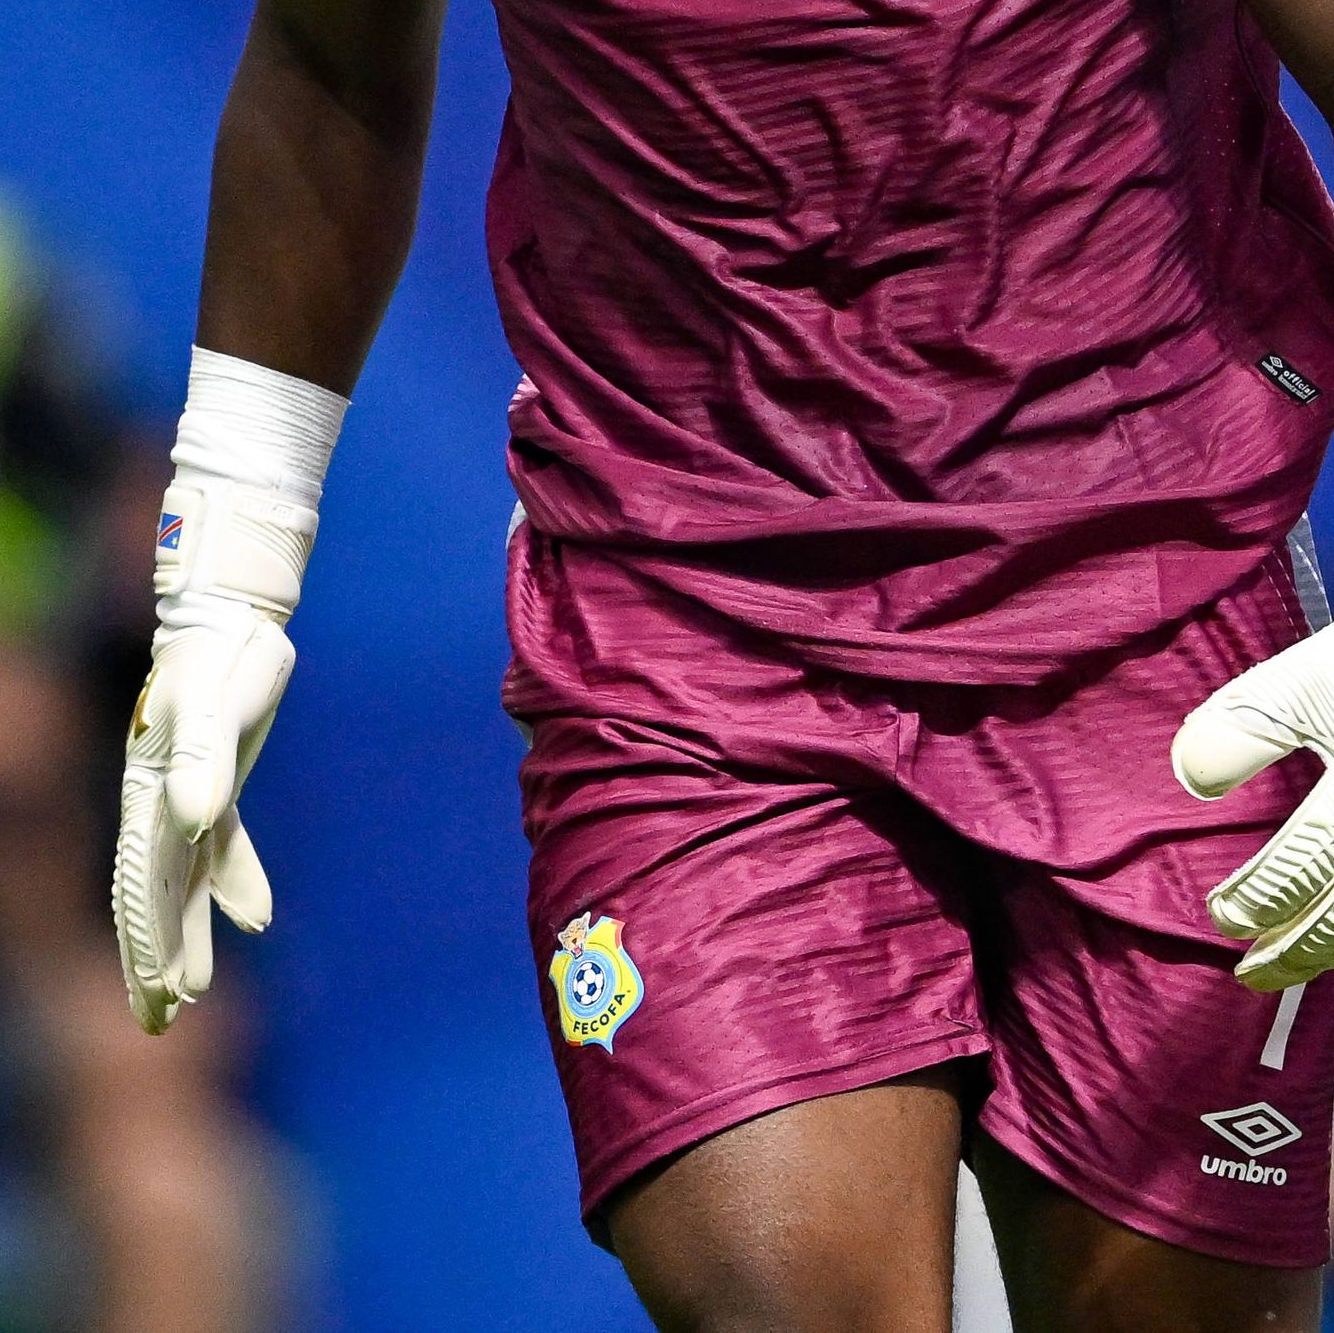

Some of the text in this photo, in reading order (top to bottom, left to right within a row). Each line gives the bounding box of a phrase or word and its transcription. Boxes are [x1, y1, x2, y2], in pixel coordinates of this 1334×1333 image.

[1283, 370, 1316, 396] official
[573, 993, 626, 1035] FECOFA
[1200, 1154, 1287, 1186] umbro
